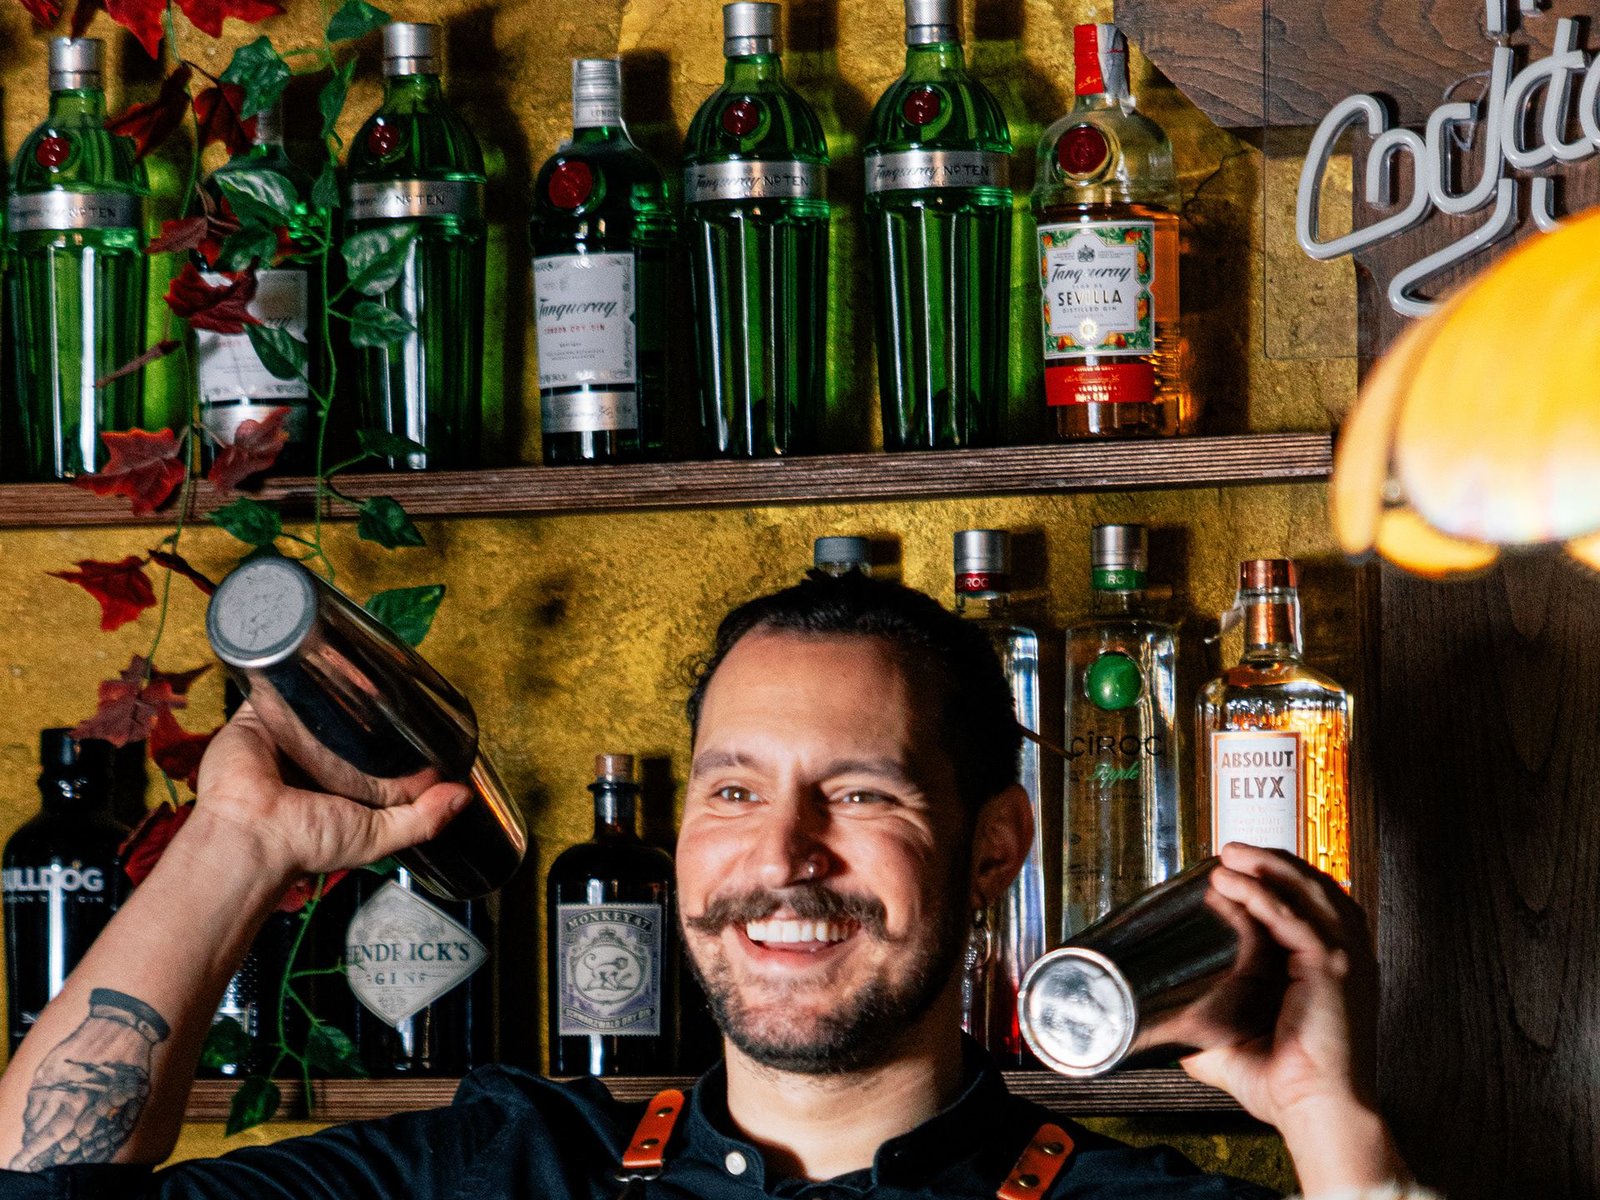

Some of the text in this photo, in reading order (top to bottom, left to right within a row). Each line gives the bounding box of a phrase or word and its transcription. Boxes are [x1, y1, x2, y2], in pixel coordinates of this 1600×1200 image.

[964, 163, 989, 176] TEN
[784, 174, 808, 187] TEN
[416, 195, 445, 205] TEN
[1052, 263, 1132, 284] Tanqueray
[1058, 289, 1123, 307] SEVILLA
[539, 298, 618, 321] Tanqueray
[1221, 750, 1294, 769] ABSOLUT
[1230, 776, 1285, 799] ELYX
[567, 912, 633, 929] MONKEY
